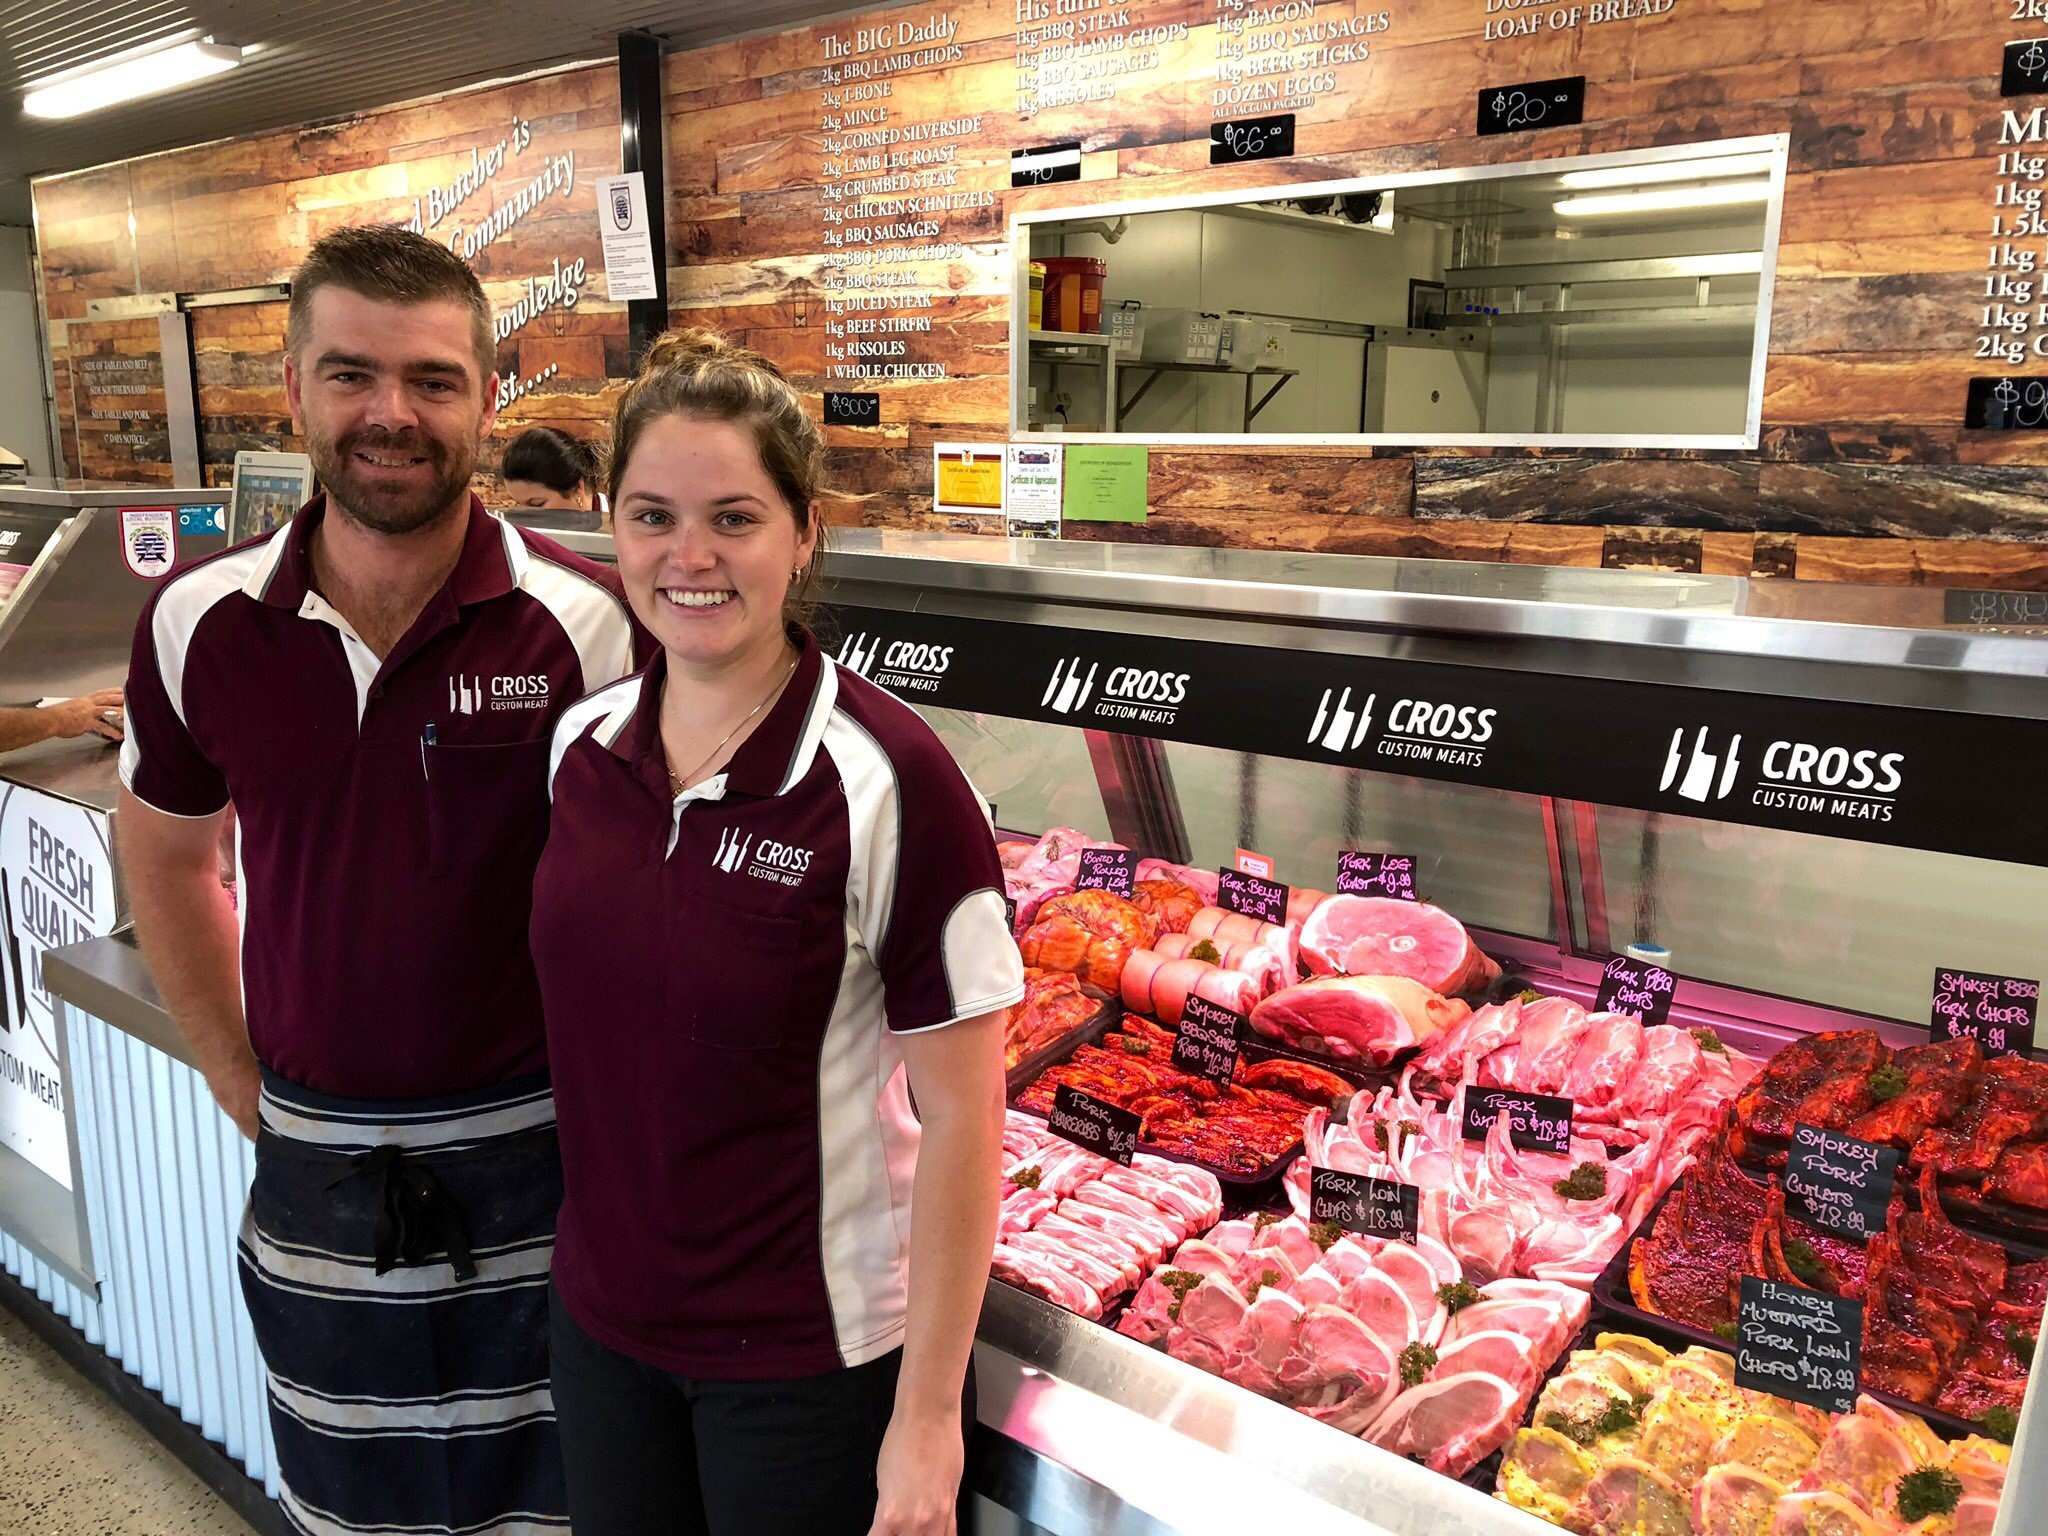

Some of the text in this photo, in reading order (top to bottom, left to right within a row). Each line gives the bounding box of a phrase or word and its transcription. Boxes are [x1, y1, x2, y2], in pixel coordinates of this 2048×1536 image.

[1016, 0, 1050, 23] His
[1216, 1, 1315, 36] 1kg BACON
[1484, 0, 1675, 41] LOAF OF BREAD
[821, 14, 959, 59] The BIG Daddy
[1016, 9, 1131, 48] 1kg BBQ STEAK
[1216, 12, 1390, 60] 1kg BBQ SAUSAGES
[1016, 21, 1190, 71] 1kg BBQ LAMB CHOPS
[821, 45, 962, 85] 2kg BBQ LAMB CHOPS
[1216, 40, 1370, 85] 1kg BEER STICKS
[821, 82, 892, 108] 2kg T-BONE
[1016, 75, 1039, 94] 1kg
[1043, 66, 1075, 86] BBQ
[1213, 72, 1336, 107] DOZEN EGGS
[821, 107, 888, 132] 2kg MINCE
[1016, 96, 1039, 116] 1kg
[821, 117, 982, 155] 2kg CORNED SILVERSIDE
[428, 115, 531, 232] Butcher is
[822, 145, 958, 178] 2kg LAMB LEG ROAST
[1996, 151, 2047, 181] 1kg
[822, 169, 957, 201] 2kg CRUMBED STEAK
[1994, 181, 2043, 212] 1kg
[447, 150, 575, 258] Community
[823, 191, 994, 224] 2kg CHICKEN SCHNITZELS
[823, 221, 939, 247] 2kg BBQ SAUSAGES
[1991, 210, 2048, 238] 1.5k
[824, 243, 962, 270] 2kg BBQ PORK CHOPS
[1988, 243, 2036, 273] 1kg
[824, 271, 917, 293] 2kg BBQ STEAK
[1984, 273, 2033, 304] 1kg
[825, 294, 933, 315] 1kg DICED STEAK
[1980, 304, 2030, 334] 1kg
[825, 317, 933, 337] 1kg BEEF STIRFRY
[825, 341, 905, 360] 1kg RISSOLES
[1974, 334, 2026, 364] 2kg
[826, 363, 945, 379] 1 WHOLE CHICKEN
[883, 640, 954, 673] CROSS
[491, 675, 549, 697] CROSS
[874, 672, 940, 692] CUSTOM MEATS
[1105, 666, 1191, 704] CROSS
[490, 698, 548, 711] CUSTOM MEATS
[1094, 703, 1177, 725] CUSTOM MEATS
[1388, 698, 1497, 743] CROSS
[1377, 740, 1484, 768] CUSTOM MEATS
[1762, 741, 1905, 793] CROSS
[1752, 789, 1894, 822] CUSTOM MEATS
[28, 816, 95, 914] FRESH
[756, 839, 814, 873] CROSS
[1338, 852, 1411, 871] PORK LEG
[748, 865, 779, 883] CUSTOM
[1079, 874, 1103, 887] LAMB
[1220, 873, 1281, 906] PORK BELLY
[1337, 872, 1377, 891] ROAST
[20, 875, 97, 949] QUALIT
[1605, 958, 1673, 992] PORK BBQ
[1940, 973, 2040, 1001] SMOKEY BBQ
[1617, 986, 1653, 1010] CHOPS
[1933, 992, 2029, 1025] PORK CHOPS
[1186, 997, 1237, 1035] SMOKEY
[1177, 1037, 1200, 1059] RIBS
[1180, 1021, 1237, 1052] BBQ SPARE
[29, 1066, 65, 1114] MEAT
[1484, 1094, 1537, 1113] PORK
[1069, 1092, 1111, 1123] PORK
[1796, 1129, 1878, 1171] SMOKEY
[1803, 1155, 1866, 1188] PORK
[1314, 1172, 1401, 1203] PORK LOIN
[1786, 1173, 1853, 1207] CUTLETS
[1315, 1197, 1352, 1221] CHOPS
[1762, 1283, 1835, 1317] HONEY
[1741, 1301, 1841, 1333] MUSTARD
[1742, 1322, 1850, 1362] PORK LOIN
[1739, 1349, 1798, 1381] CHOPS
